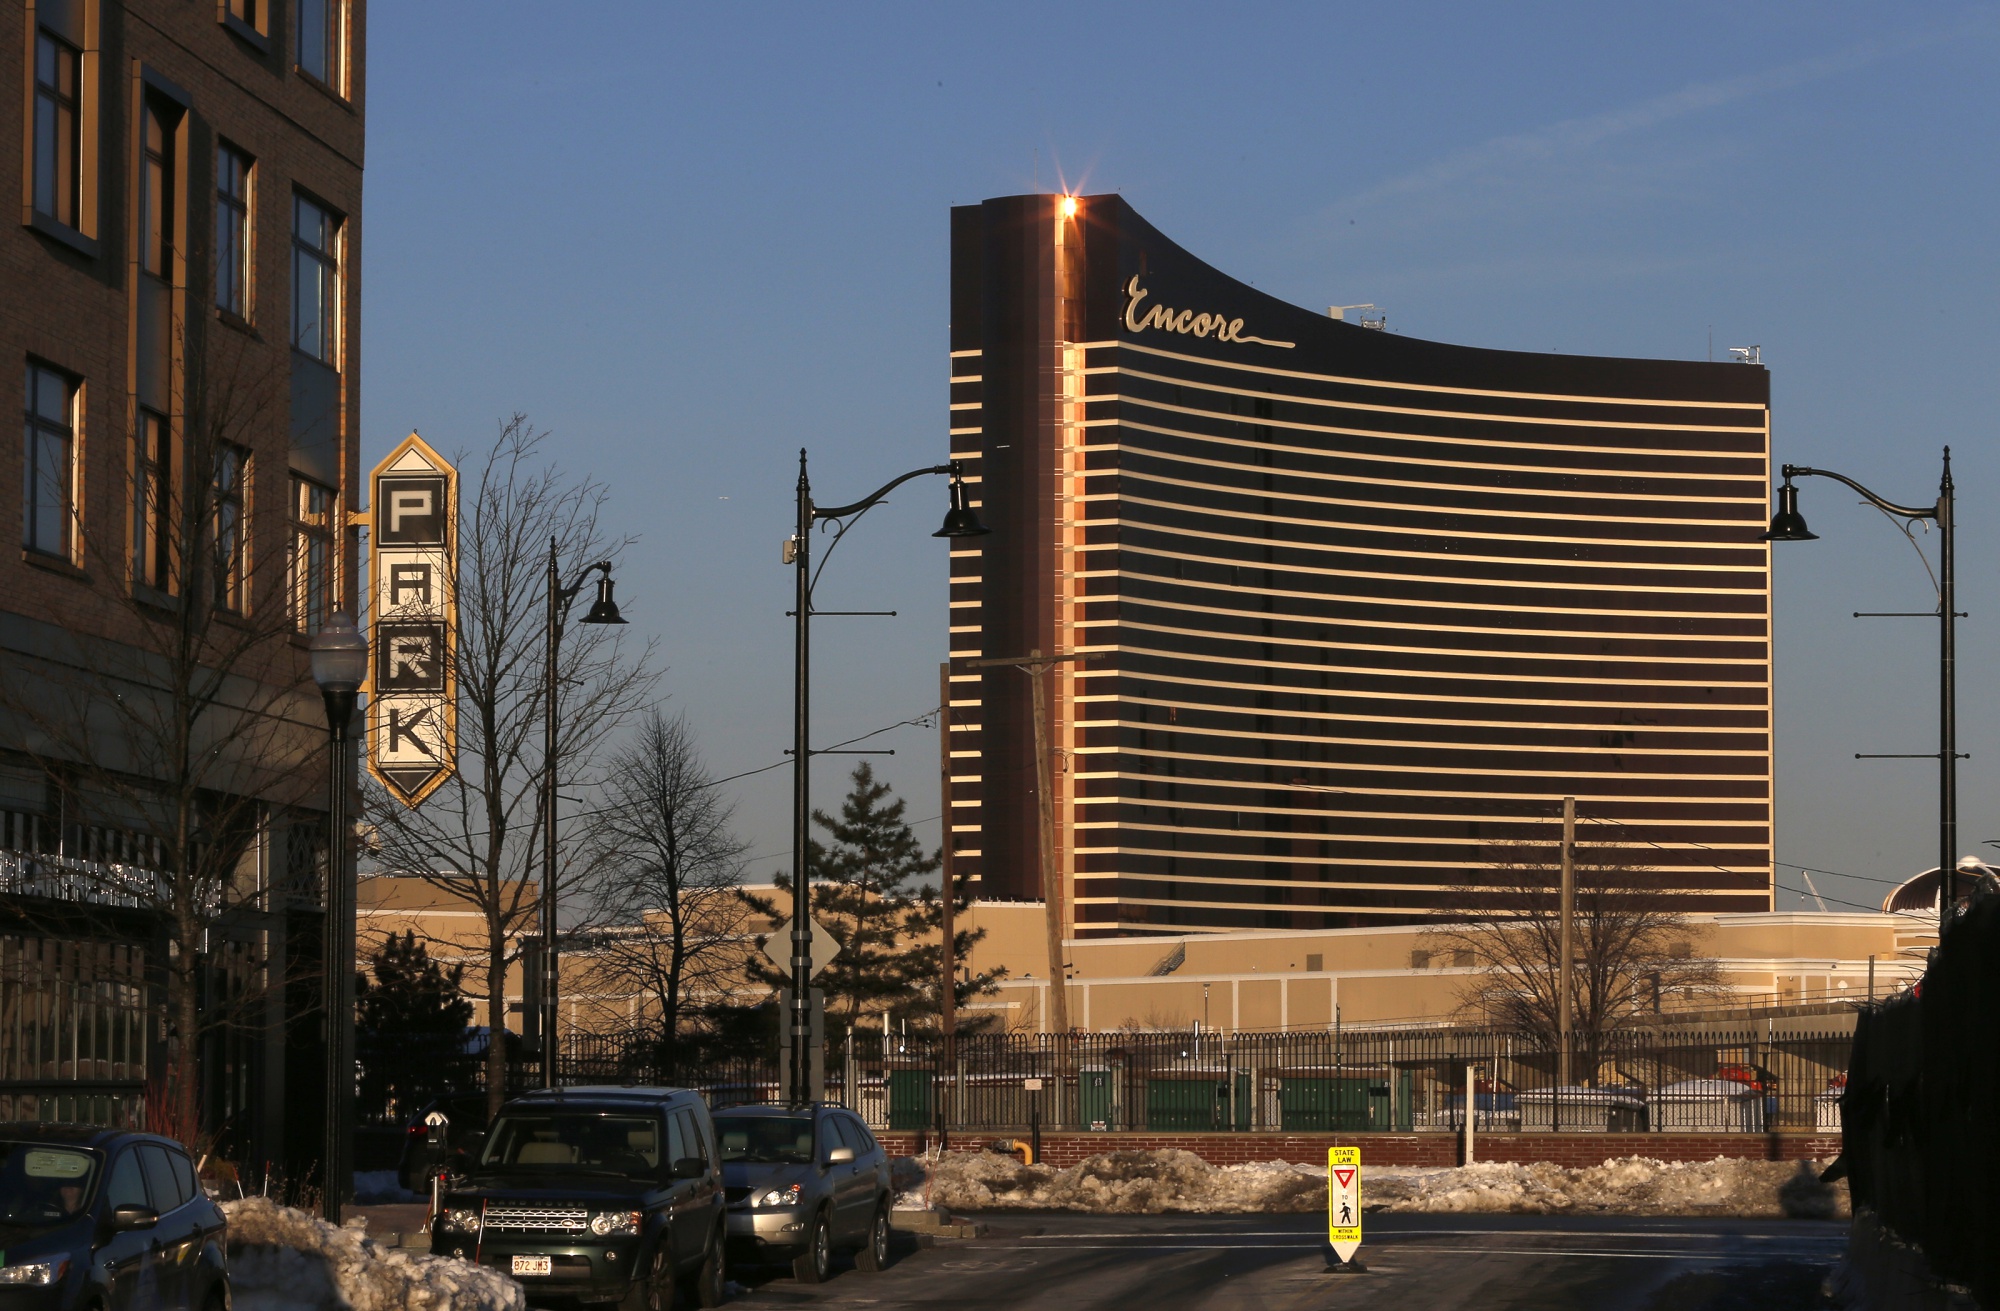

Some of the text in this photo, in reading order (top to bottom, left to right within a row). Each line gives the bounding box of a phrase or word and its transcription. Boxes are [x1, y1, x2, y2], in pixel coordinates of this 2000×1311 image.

[1125, 274, 1296, 348] Encore
[389, 490, 433, 754] PARK
[514, 1260, 530, 1271] 872
